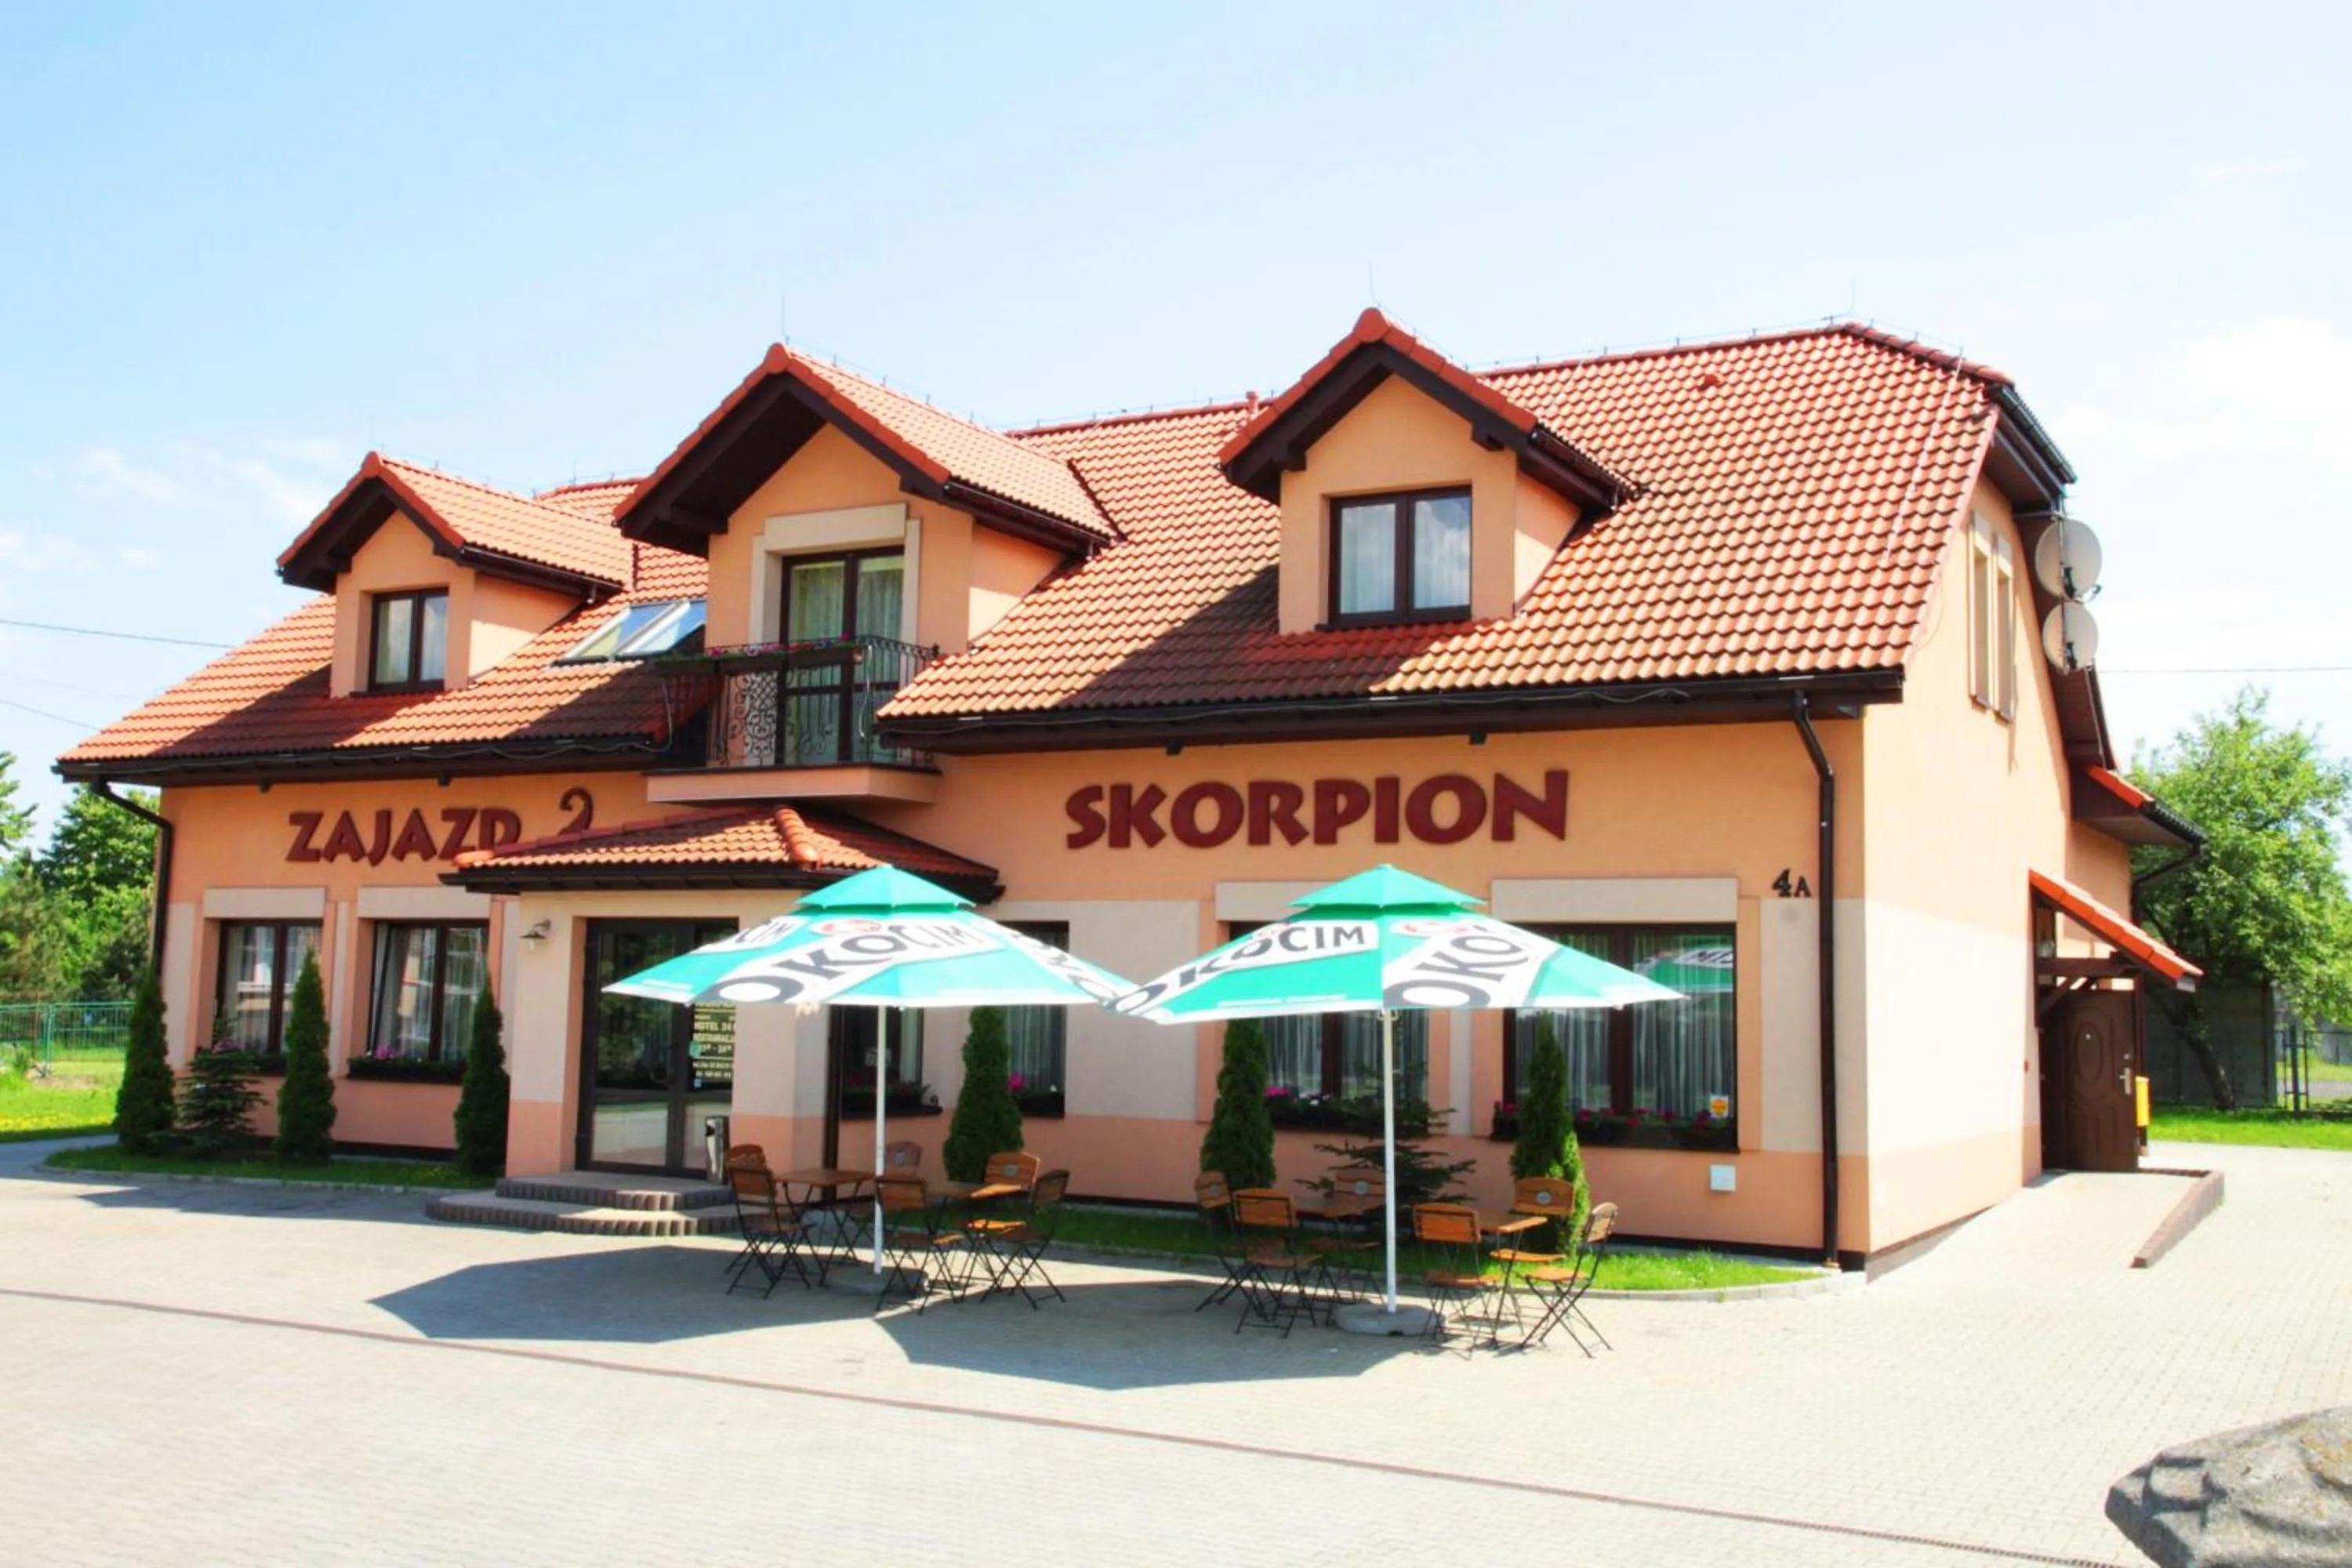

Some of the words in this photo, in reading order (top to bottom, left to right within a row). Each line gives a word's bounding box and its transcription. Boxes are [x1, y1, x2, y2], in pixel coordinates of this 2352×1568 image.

[285, 808, 522, 866] ZAJAZD
[1065, 769, 1569, 850] SKORPION
[1771, 868, 1812, 898] 4A
[1112, 926, 1365, 1013] OKOCIM
